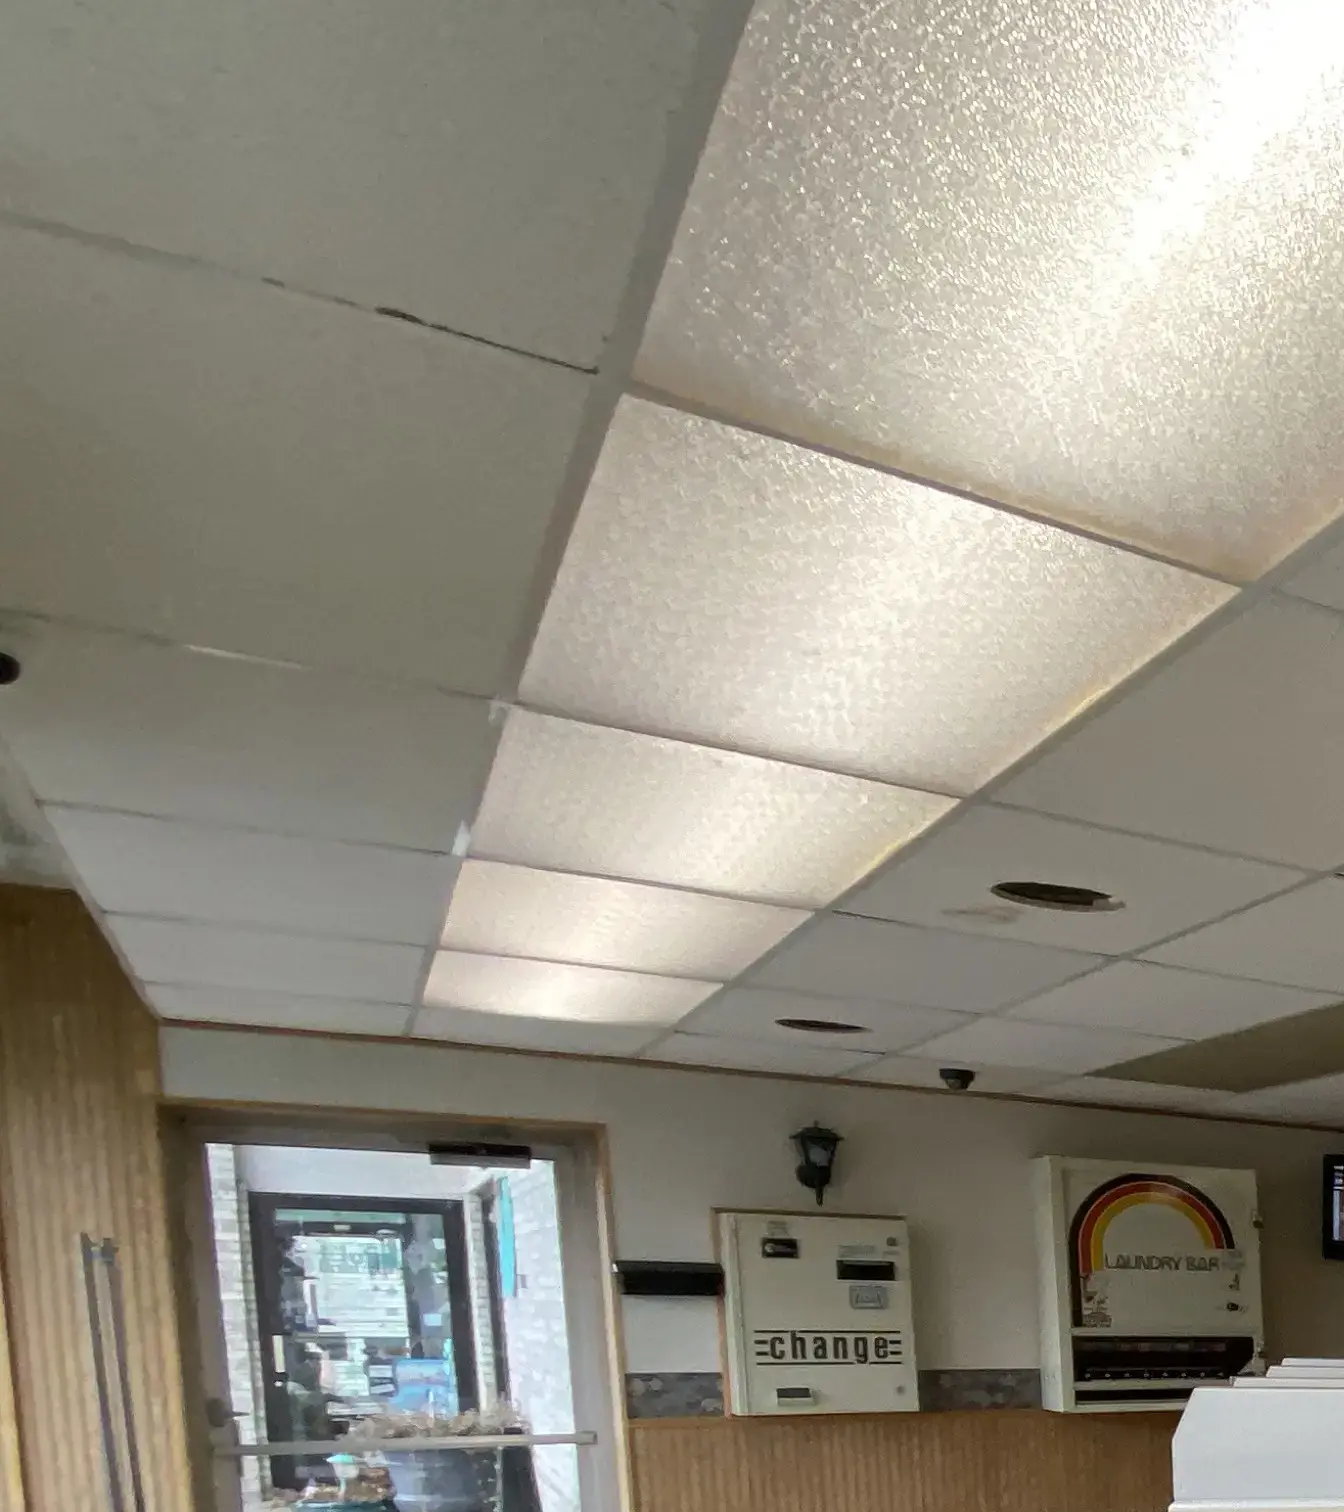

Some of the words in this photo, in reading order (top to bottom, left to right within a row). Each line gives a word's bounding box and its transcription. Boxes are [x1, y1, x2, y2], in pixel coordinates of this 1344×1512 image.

[1104, 1253, 1182, 1271] LAUNDRY
[1185, 1255, 1220, 1271] BAR
[769, 1330, 889, 1364] change
